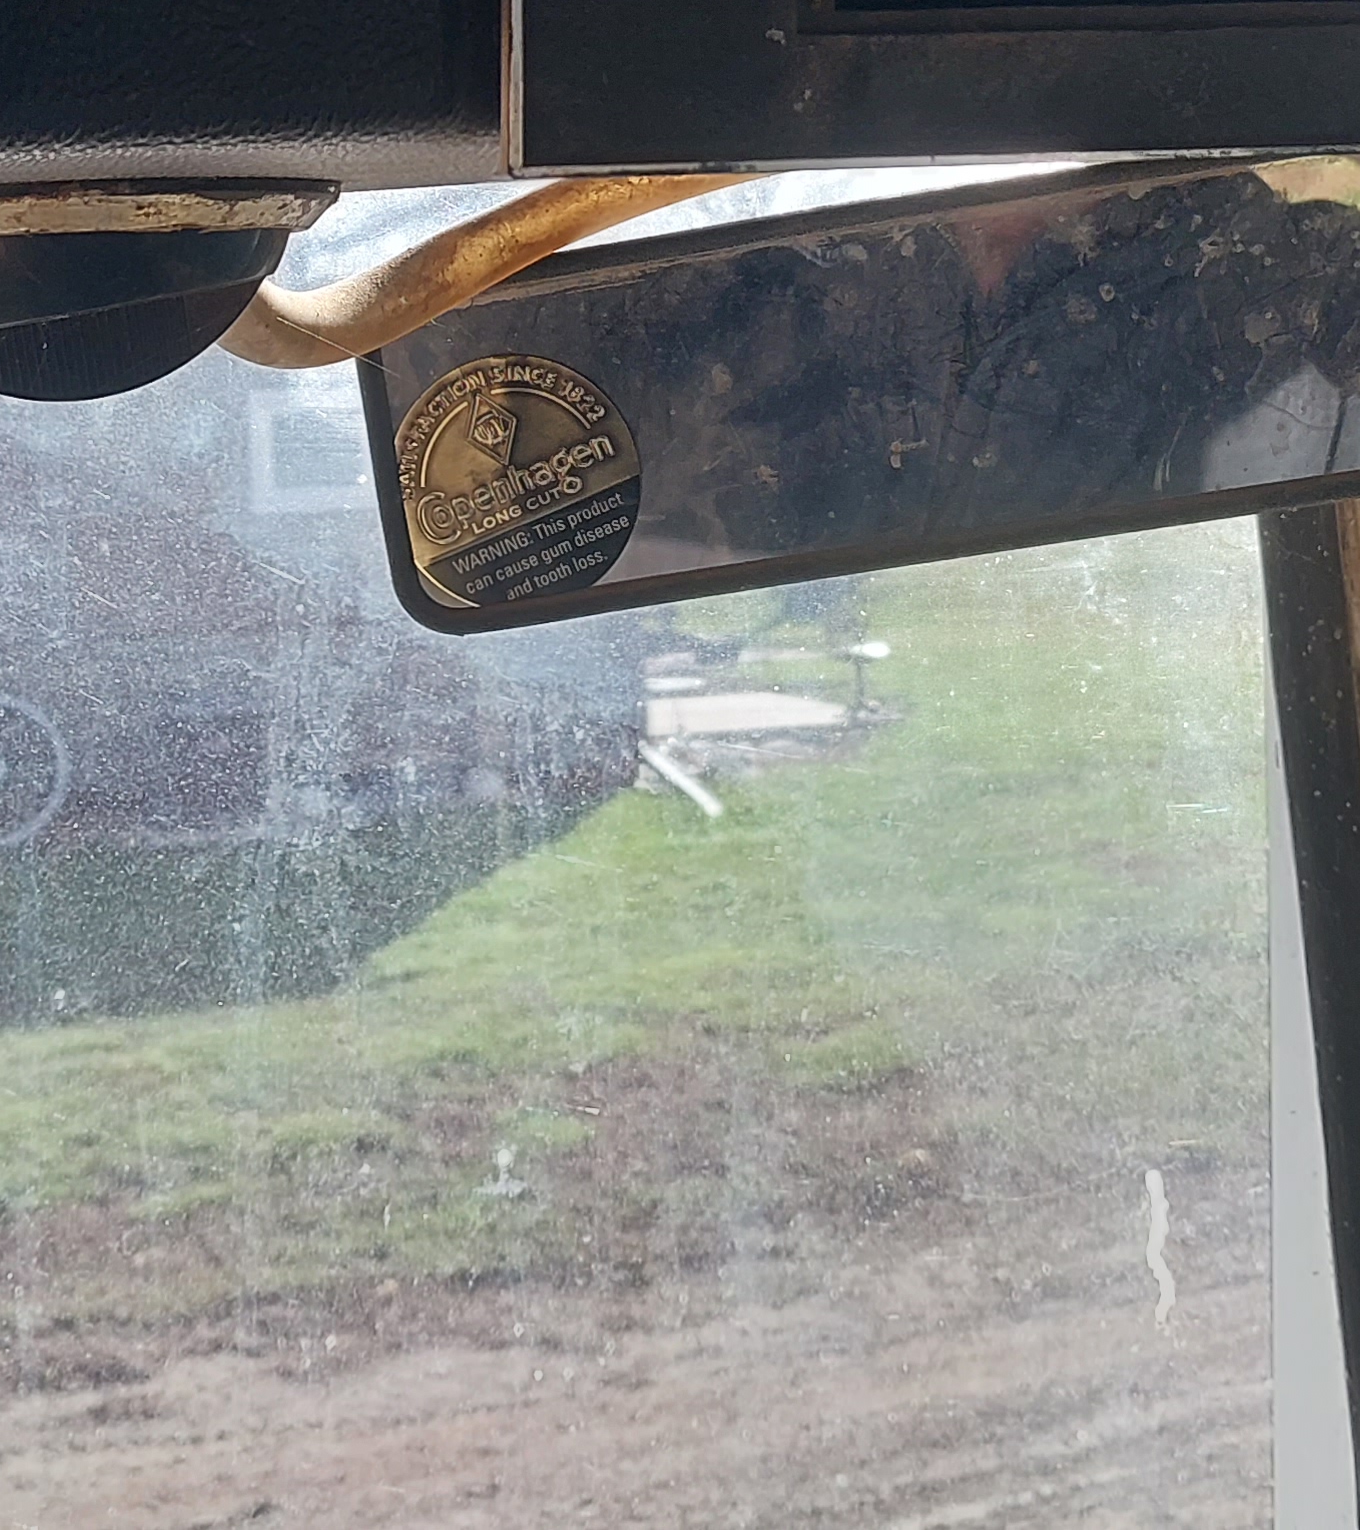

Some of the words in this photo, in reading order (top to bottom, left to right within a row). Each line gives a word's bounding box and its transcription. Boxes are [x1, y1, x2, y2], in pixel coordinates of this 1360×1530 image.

[491, 365, 557, 389] SINCE
[417, 435, 615, 544] Copenhagen
[472, 507, 521, 534] LONG
[526, 488, 562, 509] CUT
[452, 531, 534, 574] WARNING:
[535, 521, 565, 541] This
[570, 492, 625, 530] product
[465, 575, 492, 594] can
[496, 552, 538, 580] cause
[541, 541, 572, 564] gum
[575, 515, 630, 548] disease
[507, 579, 533, 601] and
[535, 560, 572, 584] tooth
[574, 549, 608, 575] loss.
